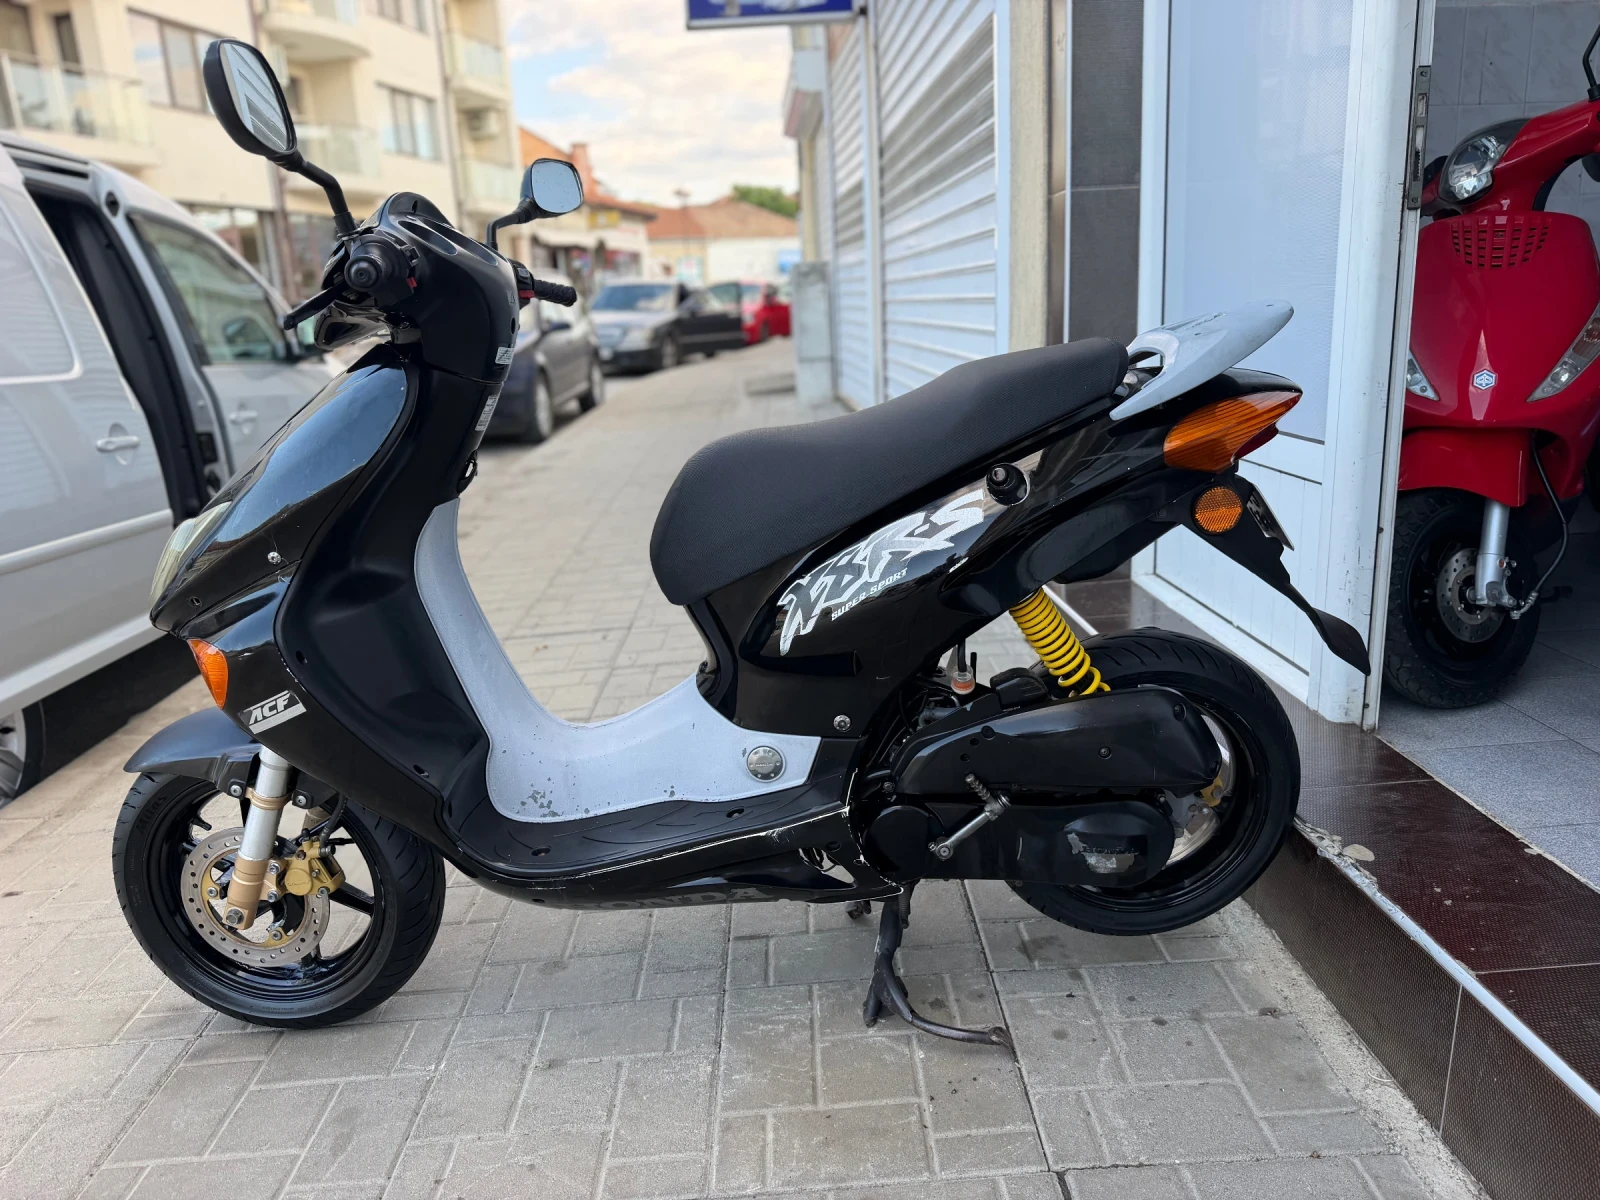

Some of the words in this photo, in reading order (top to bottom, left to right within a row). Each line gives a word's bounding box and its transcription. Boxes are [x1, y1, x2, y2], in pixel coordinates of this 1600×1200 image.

[831, 591, 867, 621] SUPER
[869, 567, 909, 595] SPORT
[248, 692, 291, 726] ACF
